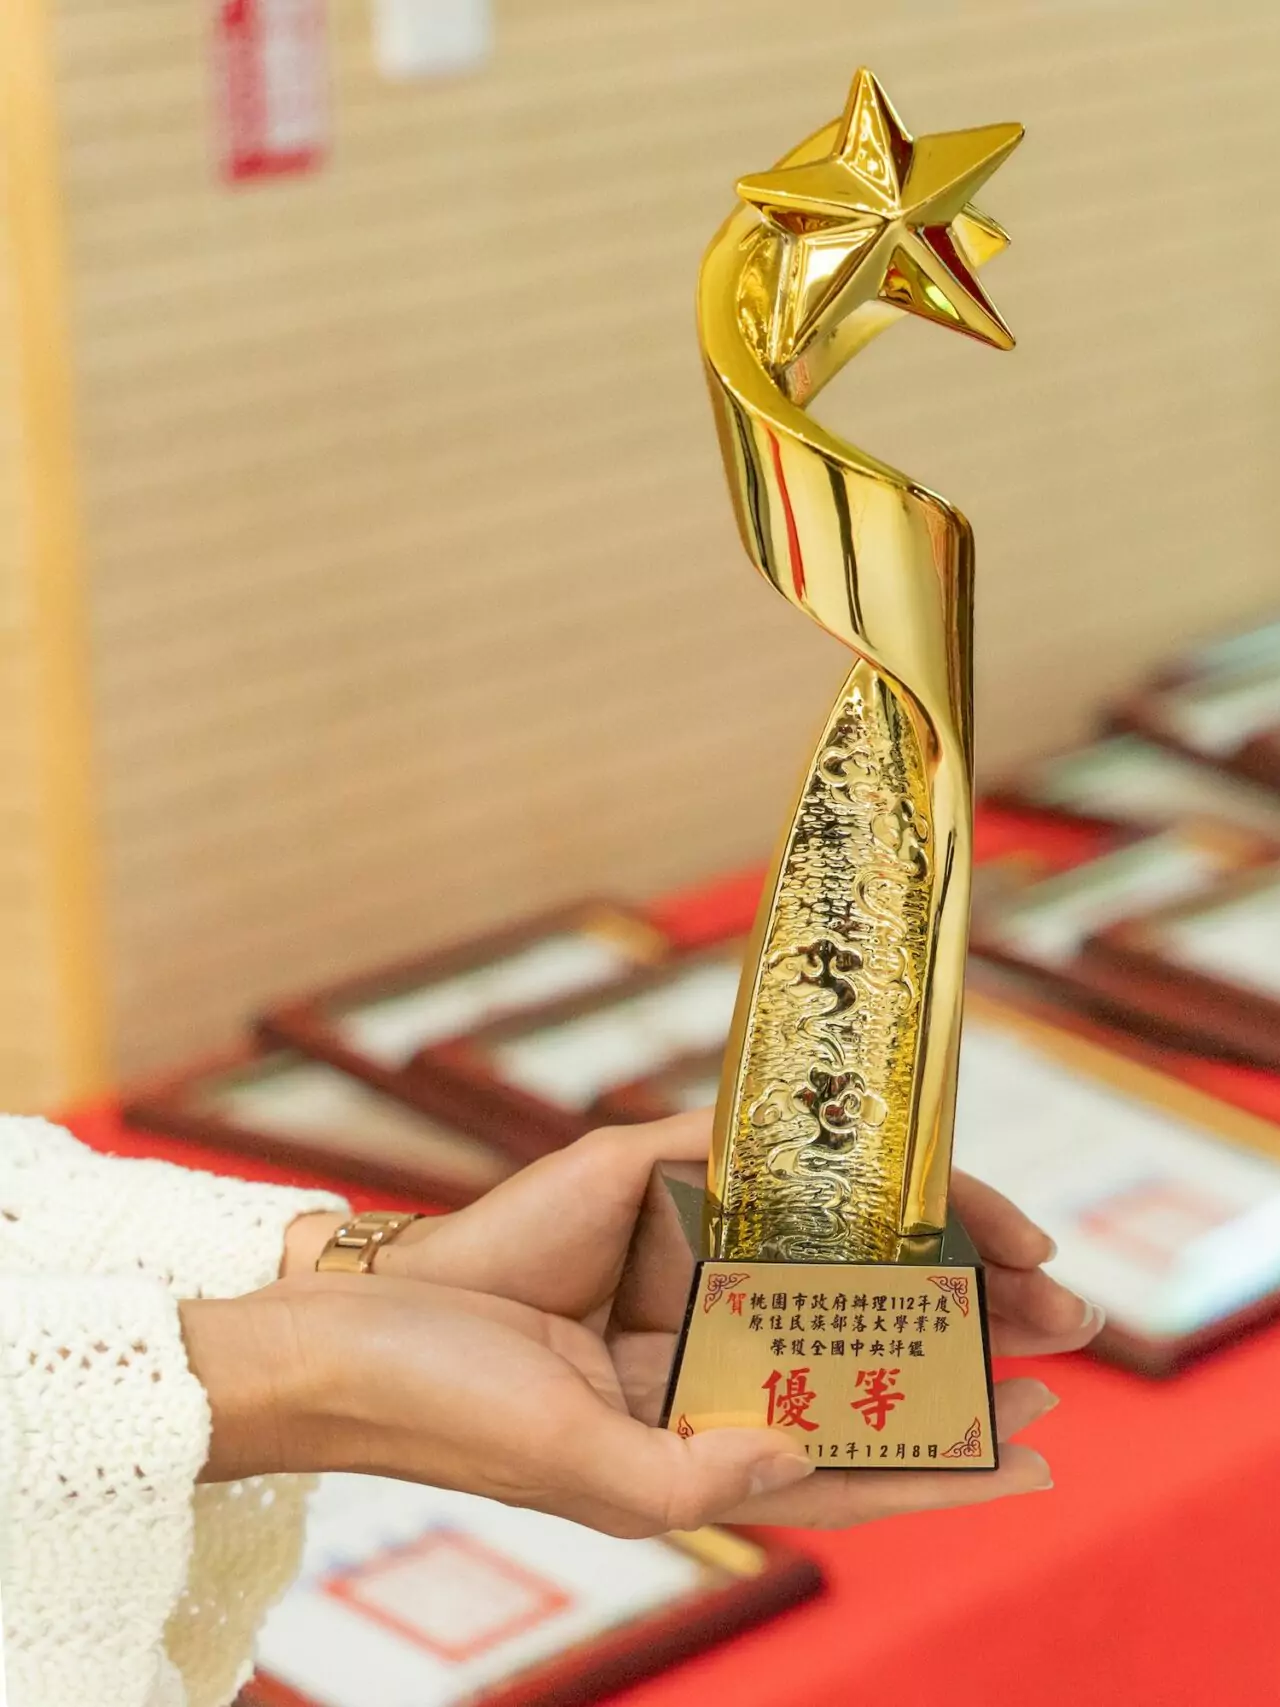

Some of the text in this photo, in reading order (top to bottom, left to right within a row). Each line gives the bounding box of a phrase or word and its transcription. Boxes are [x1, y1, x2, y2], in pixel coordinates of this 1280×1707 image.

[748, 1314, 950, 1333] 原住民族部落大學業務
[770, 1338, 925, 1358] 榮獲全國中央評鑑
[761, 1367, 906, 1431] 優等
